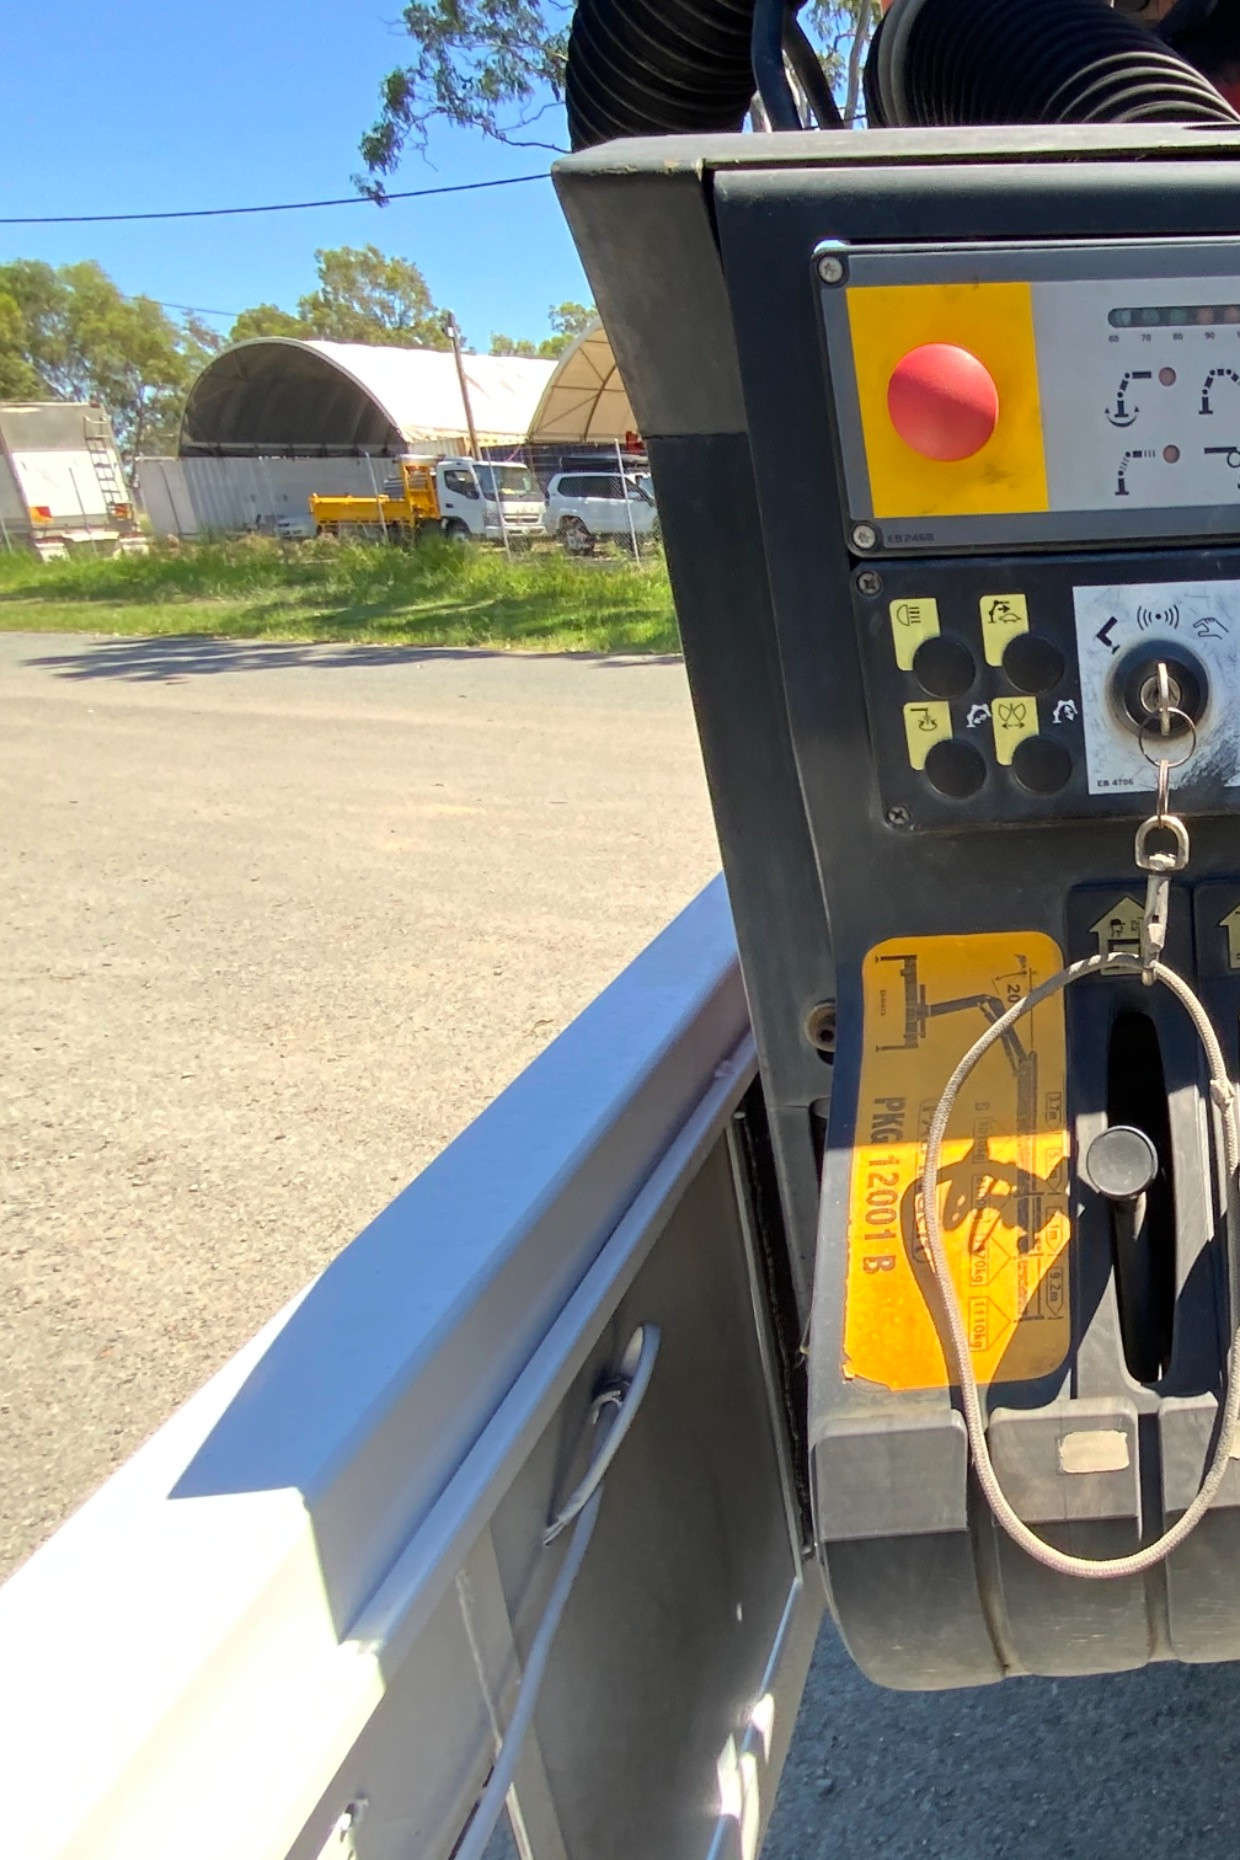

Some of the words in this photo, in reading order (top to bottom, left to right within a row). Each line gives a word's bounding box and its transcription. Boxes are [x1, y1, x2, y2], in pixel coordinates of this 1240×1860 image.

[1108, 335, 1119, 343] 60
[1141, 334, 1151, 342] 70
[1172, 333, 1183, 341] 80
[1204, 331, 1215, 340] 90
[870, 1096, 906, 1144] PKG
[864, 1155, 900, 1241] 12001
[862, 1254, 897, 1275] B
[969, 1302, 986, 1348] 1110kg
